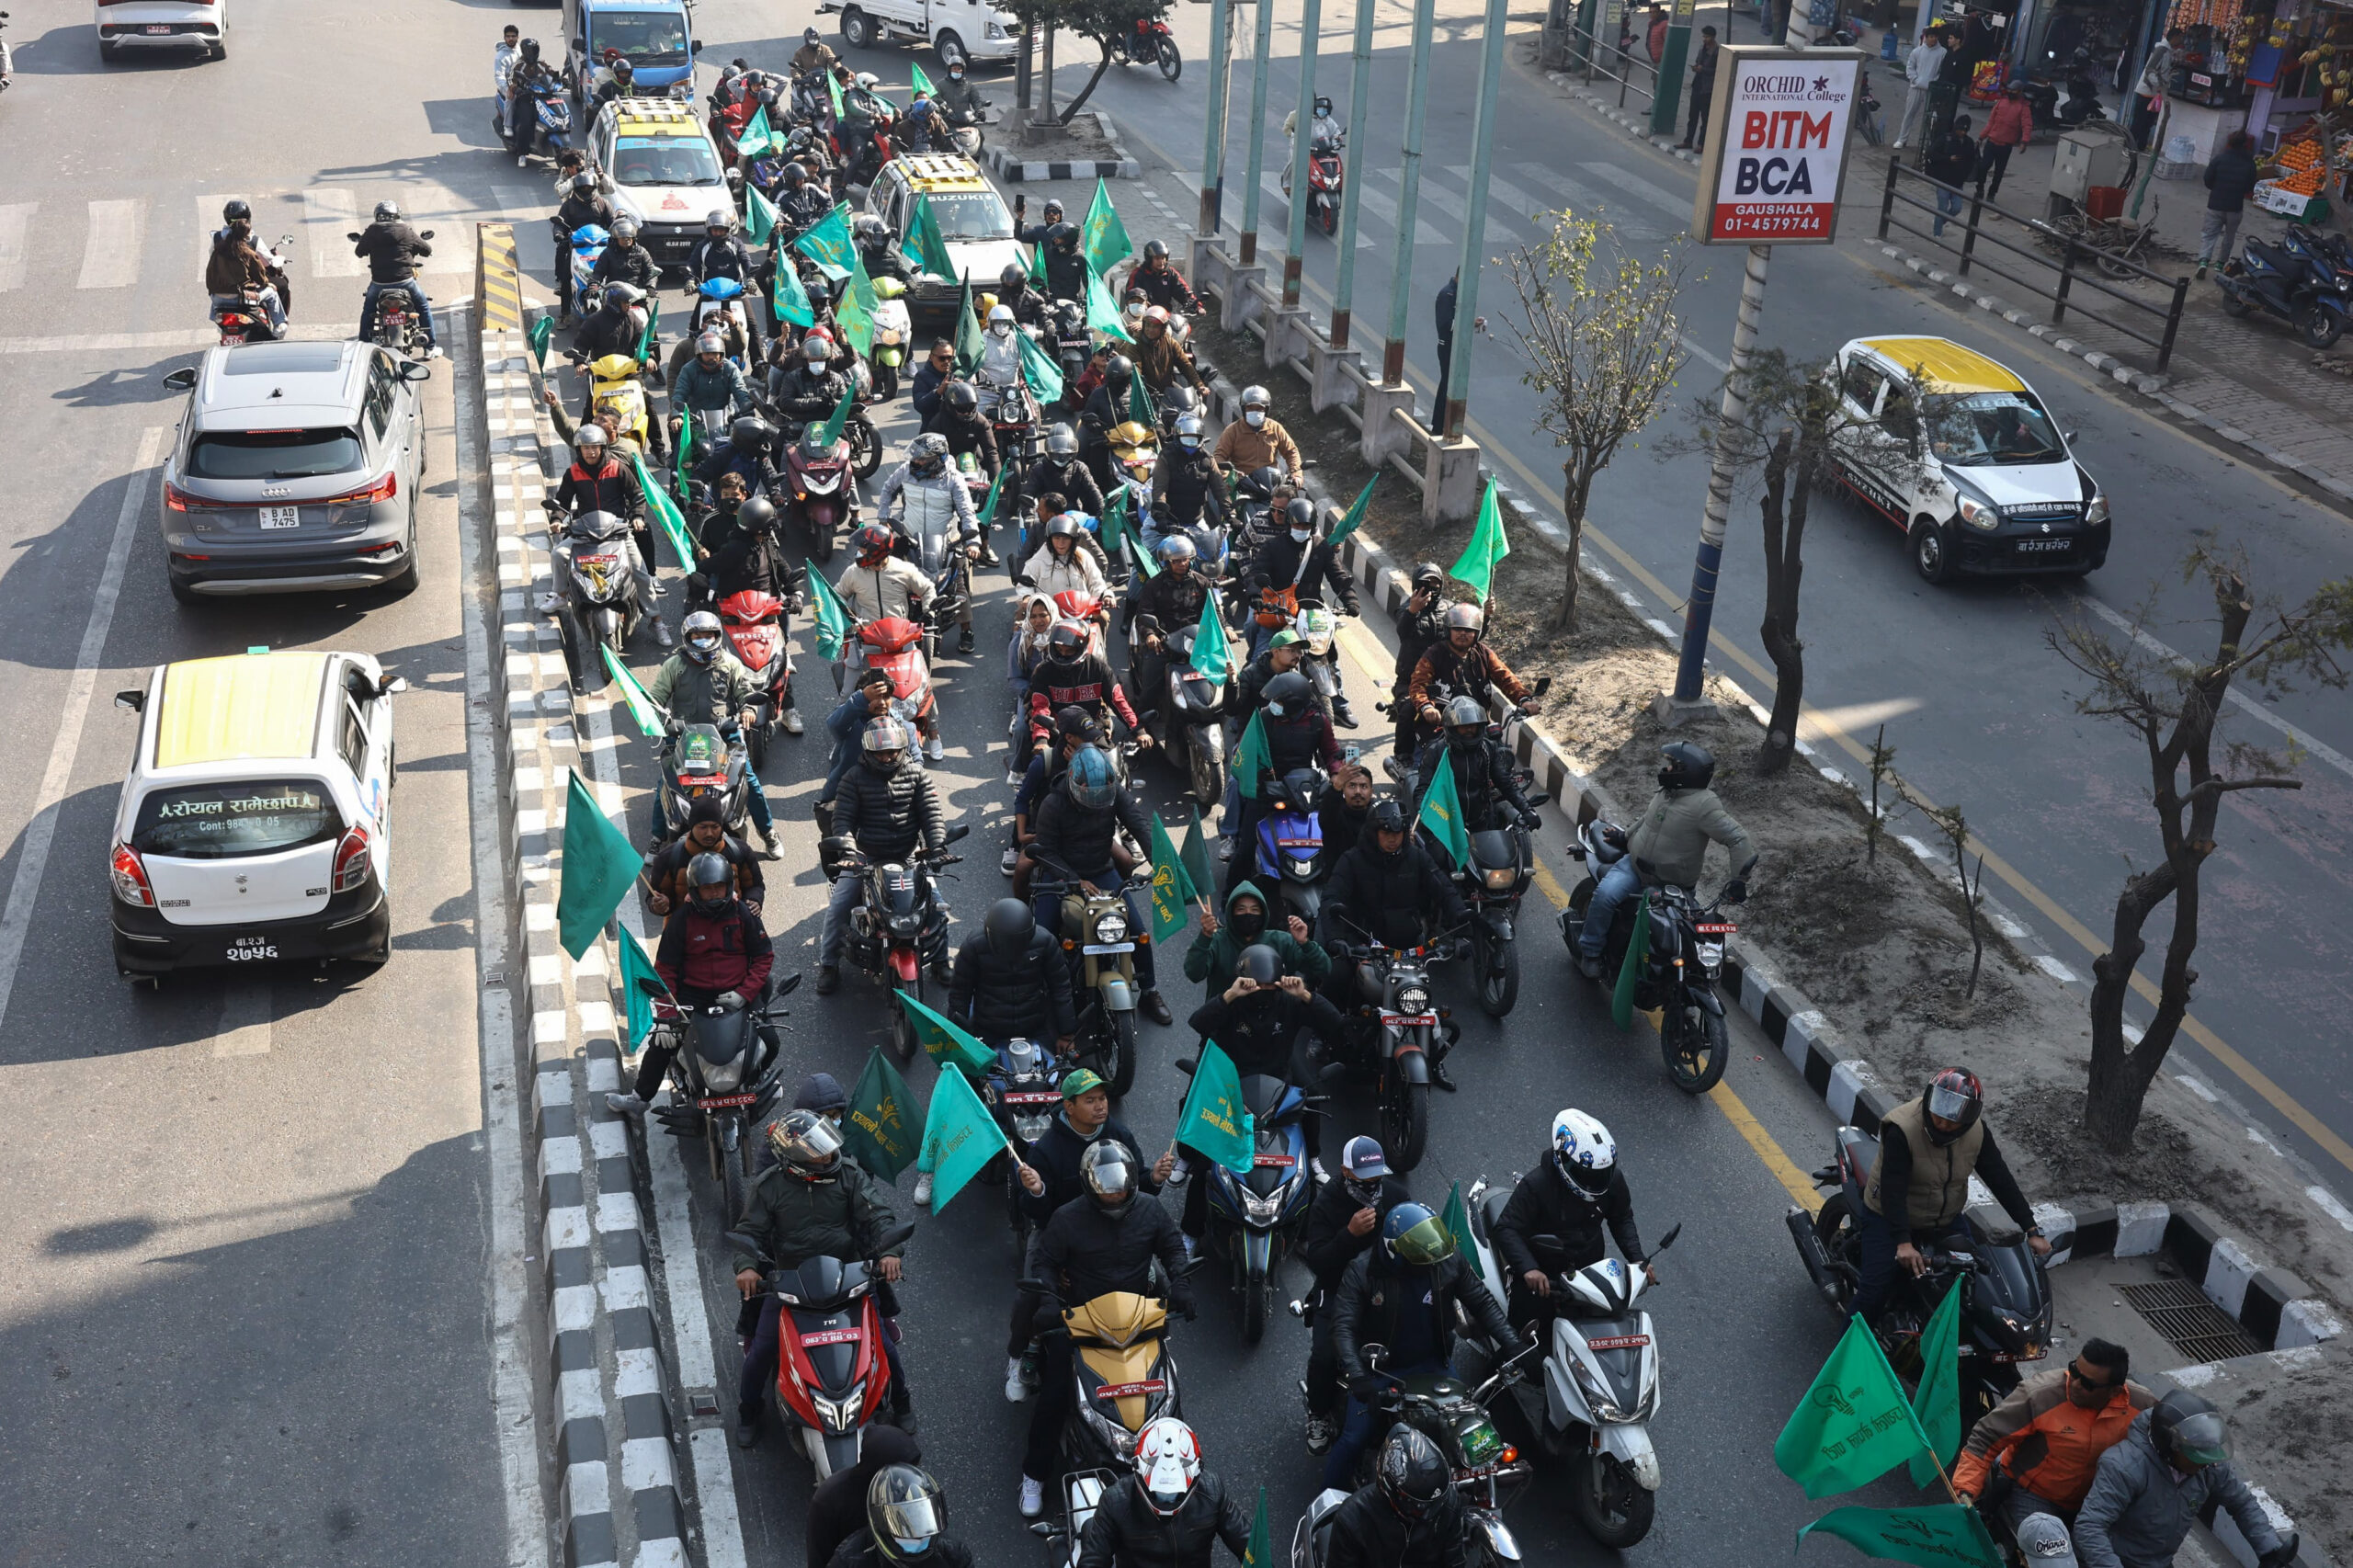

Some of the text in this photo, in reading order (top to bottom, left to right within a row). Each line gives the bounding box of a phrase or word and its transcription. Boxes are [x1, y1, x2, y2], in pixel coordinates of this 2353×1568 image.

[1744, 75, 1806, 94] ORCHID
[1807, 91, 1847, 103] College
[1742, 110, 1833, 149] BITM
[1734, 157, 1813, 196] BCA
[927, 194, 983, 202] SUZUKI
[1735, 204, 1814, 215] GAUSHALA
[1724, 217, 1820, 231] 01-4579744
[271, 507, 295, 518] B AD
[271, 517, 296, 528] 7475
[173, 796, 299, 816] रोयल रामेछाप
[226, 945, 278, 961] २७५६
[1472, 1435, 1492, 1452] BACK
